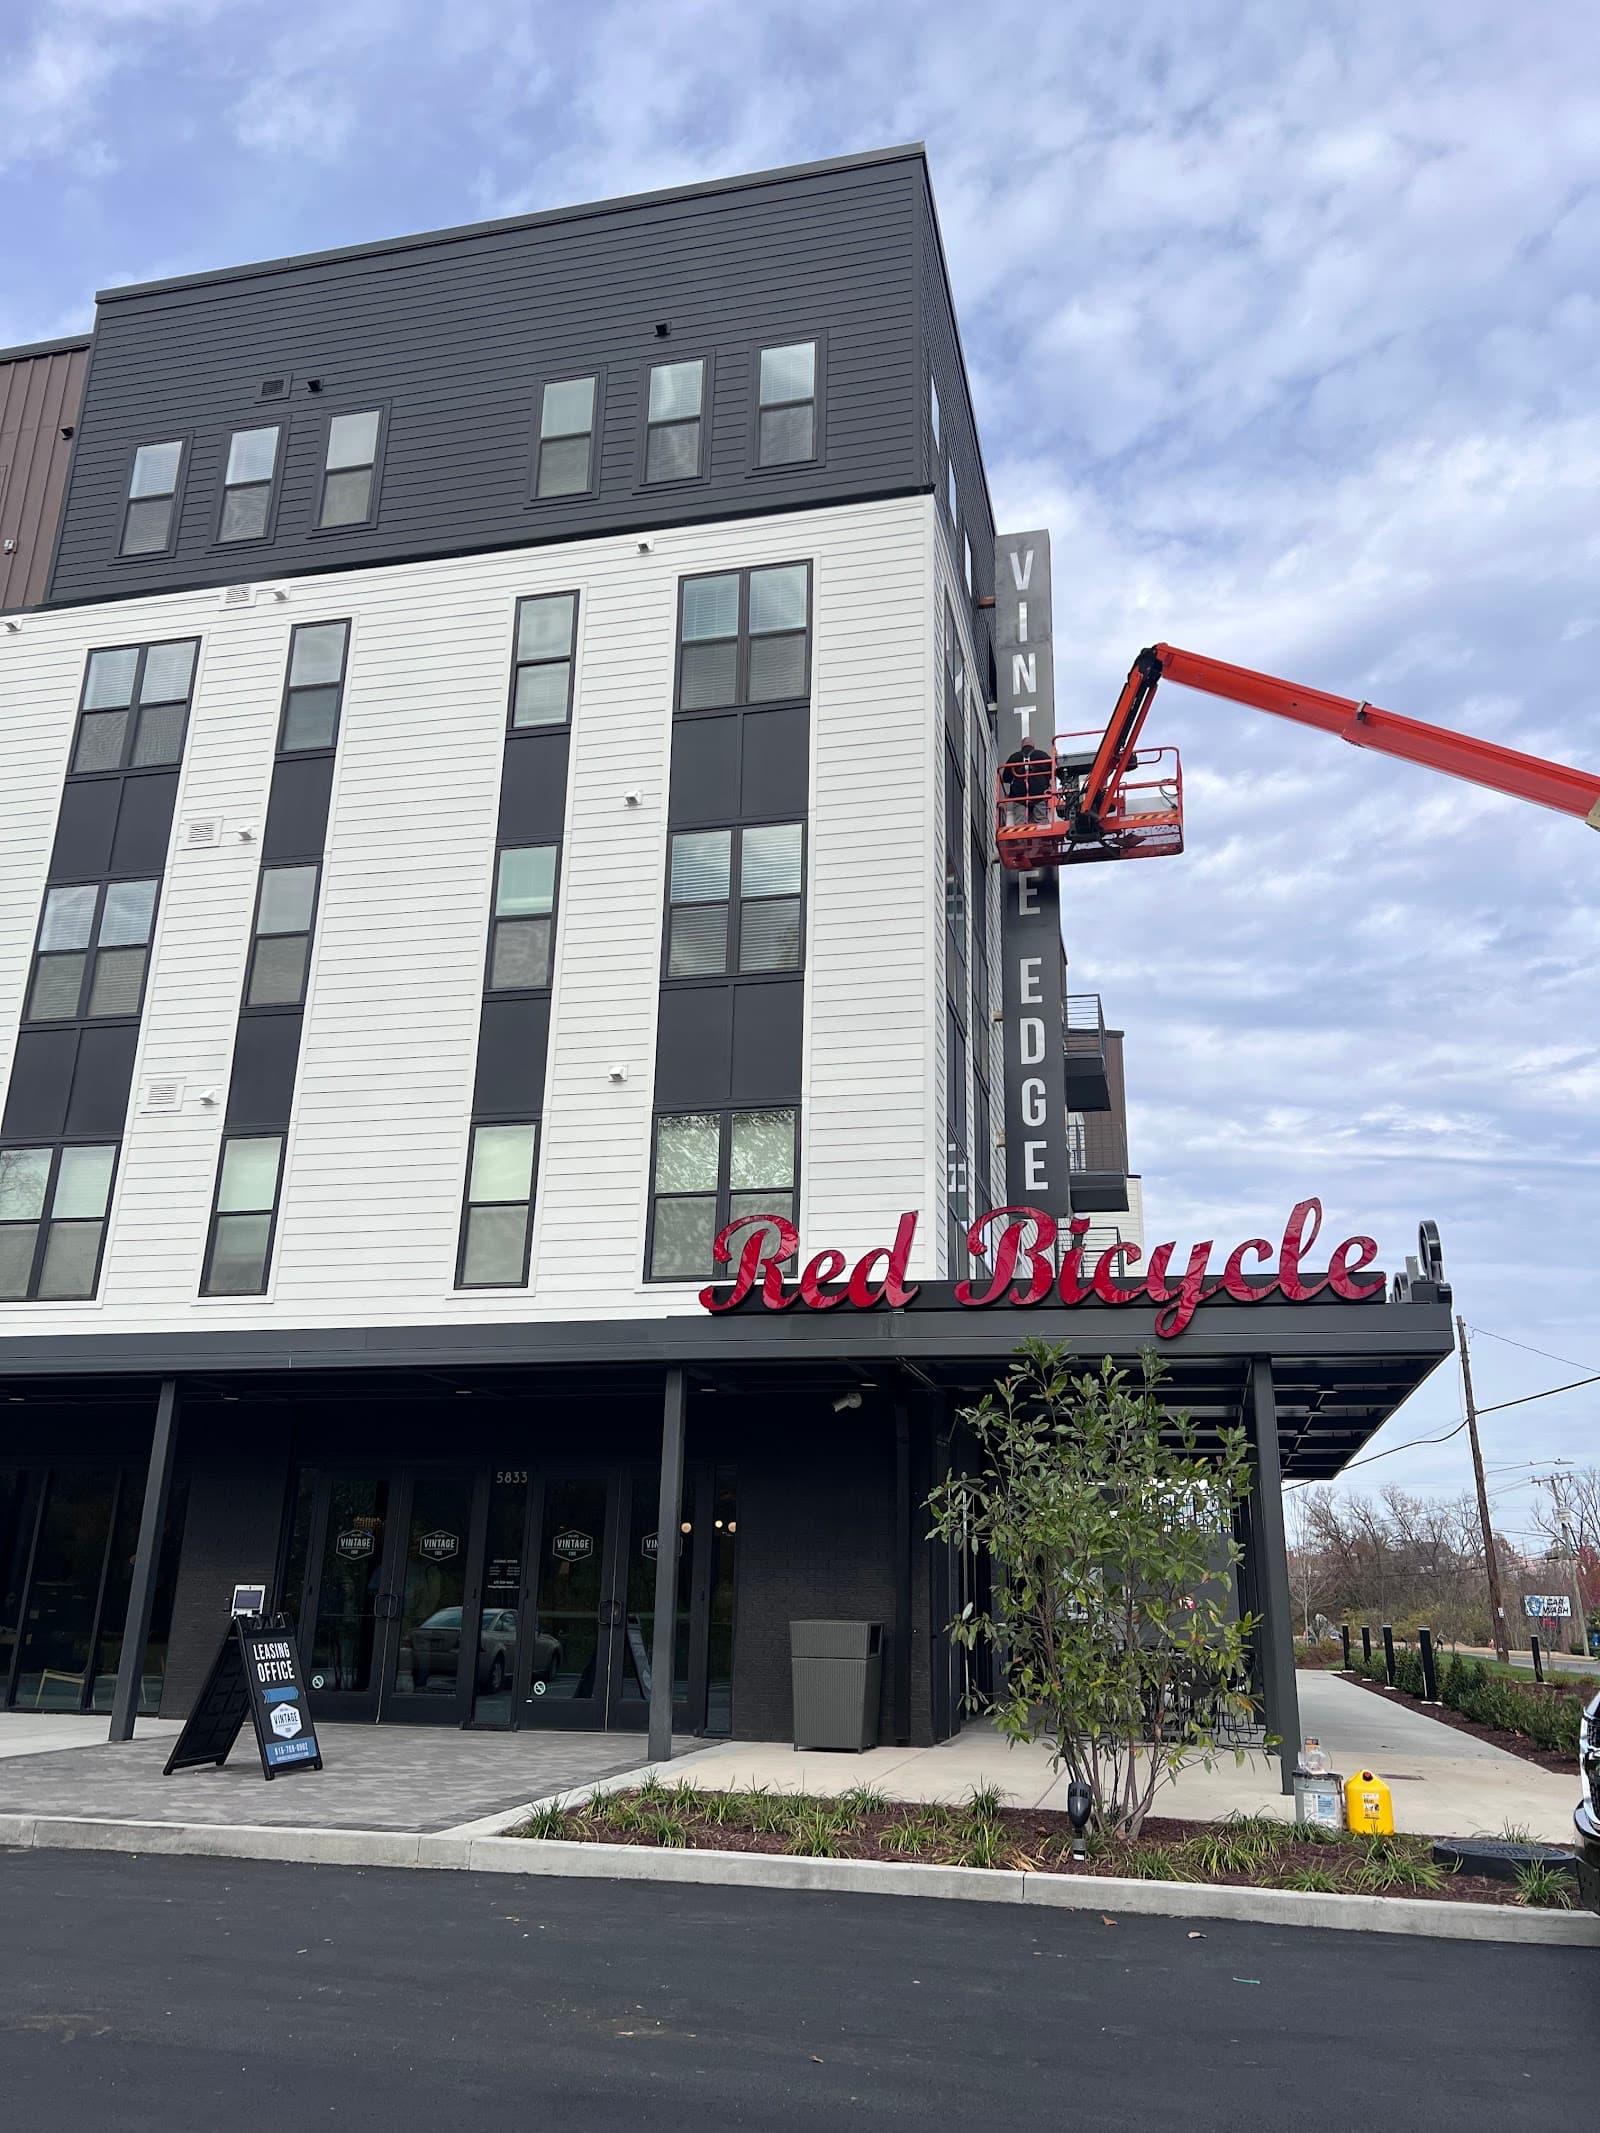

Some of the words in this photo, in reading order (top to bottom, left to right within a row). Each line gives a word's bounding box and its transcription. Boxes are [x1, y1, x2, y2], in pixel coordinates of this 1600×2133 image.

[1010, 550, 1041, 916] VINTE
[1020, 957, 1049, 1191] EDGE
[699, 1211, 920, 1311] Red
[953, 1197, 1387, 1339] Bicycle
[496, 1471, 528, 1484] 5833
[340, 1538, 371, 1547] VINTAGE
[424, 1539, 455, 1548] VINTAGE
[557, 1539, 589, 1548] VINTAGE
[253, 1642, 291, 1660] LEASING
[257, 1660, 295, 1682] OFFICE
[273, 1712, 299, 1725] VINTAGE
